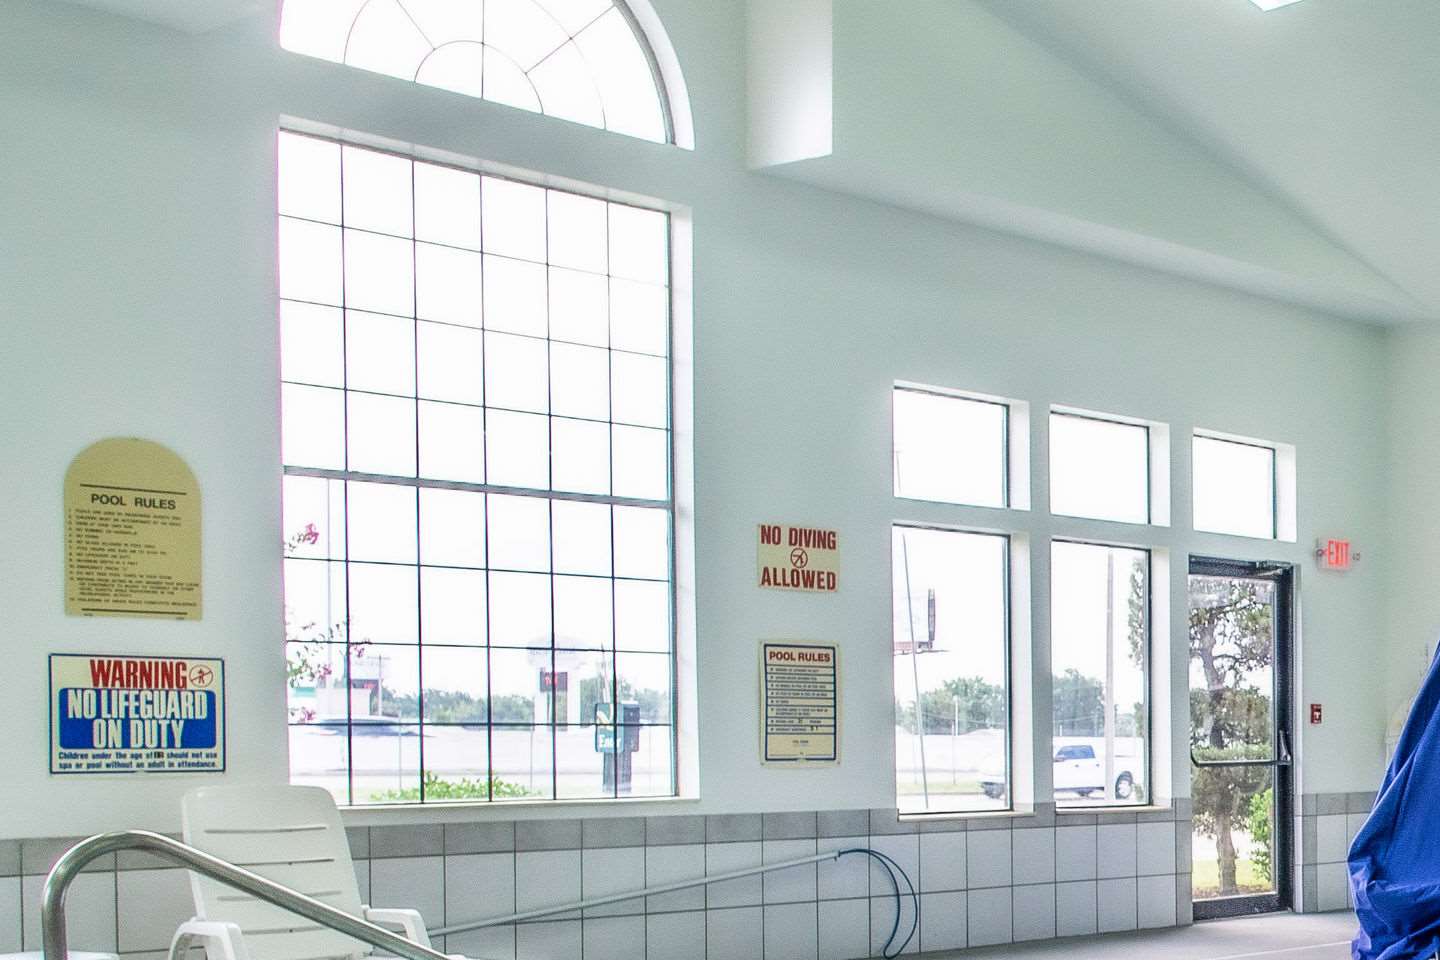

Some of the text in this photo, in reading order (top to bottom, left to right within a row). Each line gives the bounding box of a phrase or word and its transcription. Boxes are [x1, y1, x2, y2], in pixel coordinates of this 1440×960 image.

[91, 494, 176, 510] POOL RULES
[761, 525, 837, 550] NO DIVING
[1328, 540, 1350, 566] EXIT
[761, 567, 836, 590] ALLOWED
[769, 650, 831, 663] POOL RULES
[90, 659, 188, 688] WARNING
[67, 689, 207, 719] NO LIFEGUARD
[93, 719, 184, 748] ON DUTY
[58, 751, 88, 759] Children
[116, 751, 127, 759] the
[87, 762, 102, 770] pool
[106, 761, 133, 769] without
